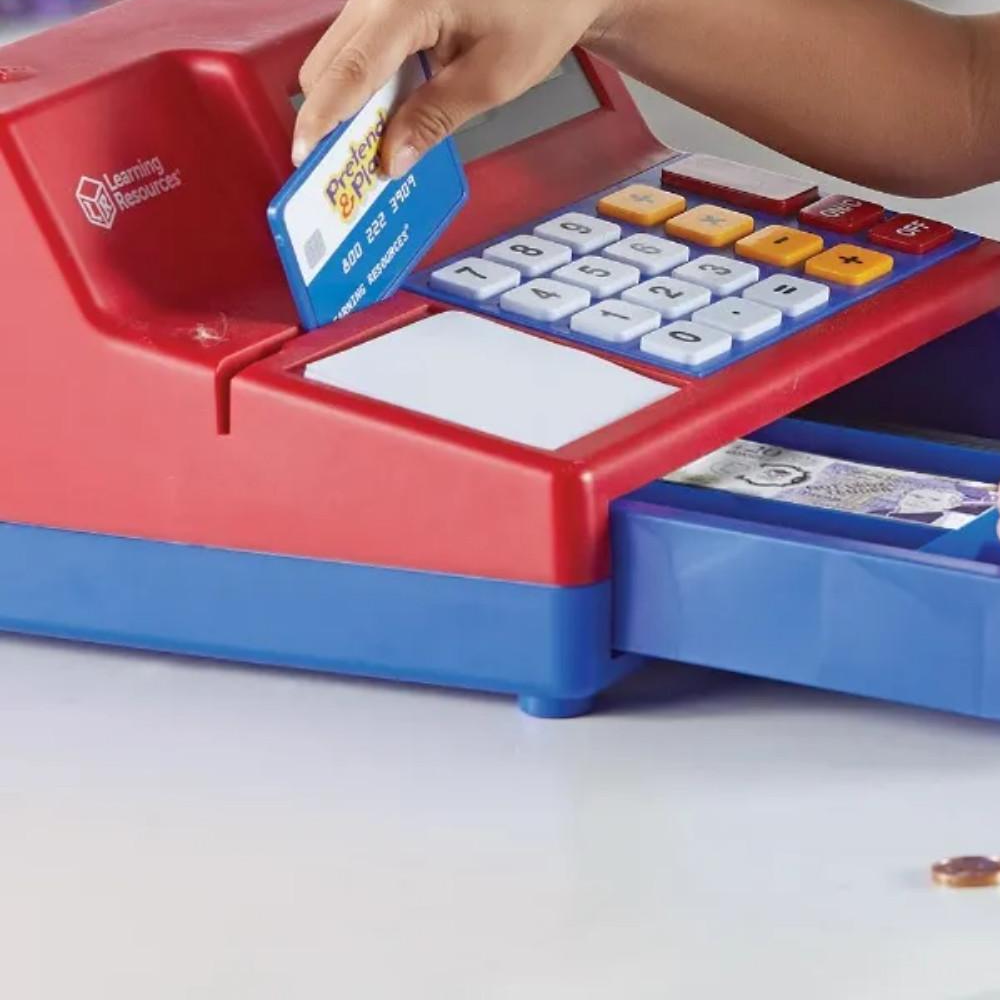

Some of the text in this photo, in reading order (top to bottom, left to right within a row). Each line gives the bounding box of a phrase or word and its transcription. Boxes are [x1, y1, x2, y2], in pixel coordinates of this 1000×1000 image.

[326, 111, 387, 207] Pretend
[103, 156, 165, 191] Learning
[339, 154, 380, 219] & Pla
[365, 211, 388, 245] 222
[389, 174, 416, 214] 3909
[560, 222, 593, 235] 9
[896, 219, 930, 238] OFF
[509, 243, 544, 257] 8
[629, 242, 662, 255] 6
[454, 265, 488, 280] 7
[578, 264, 611, 278] 5
[698, 262, 732, 276] 3
[530, 287, 562, 300] 4
[649, 285, 685, 299] 2
[333, 283, 367, 321] ARNING
[600, 308, 631, 321] 1
[668, 330, 702, 344] 0
